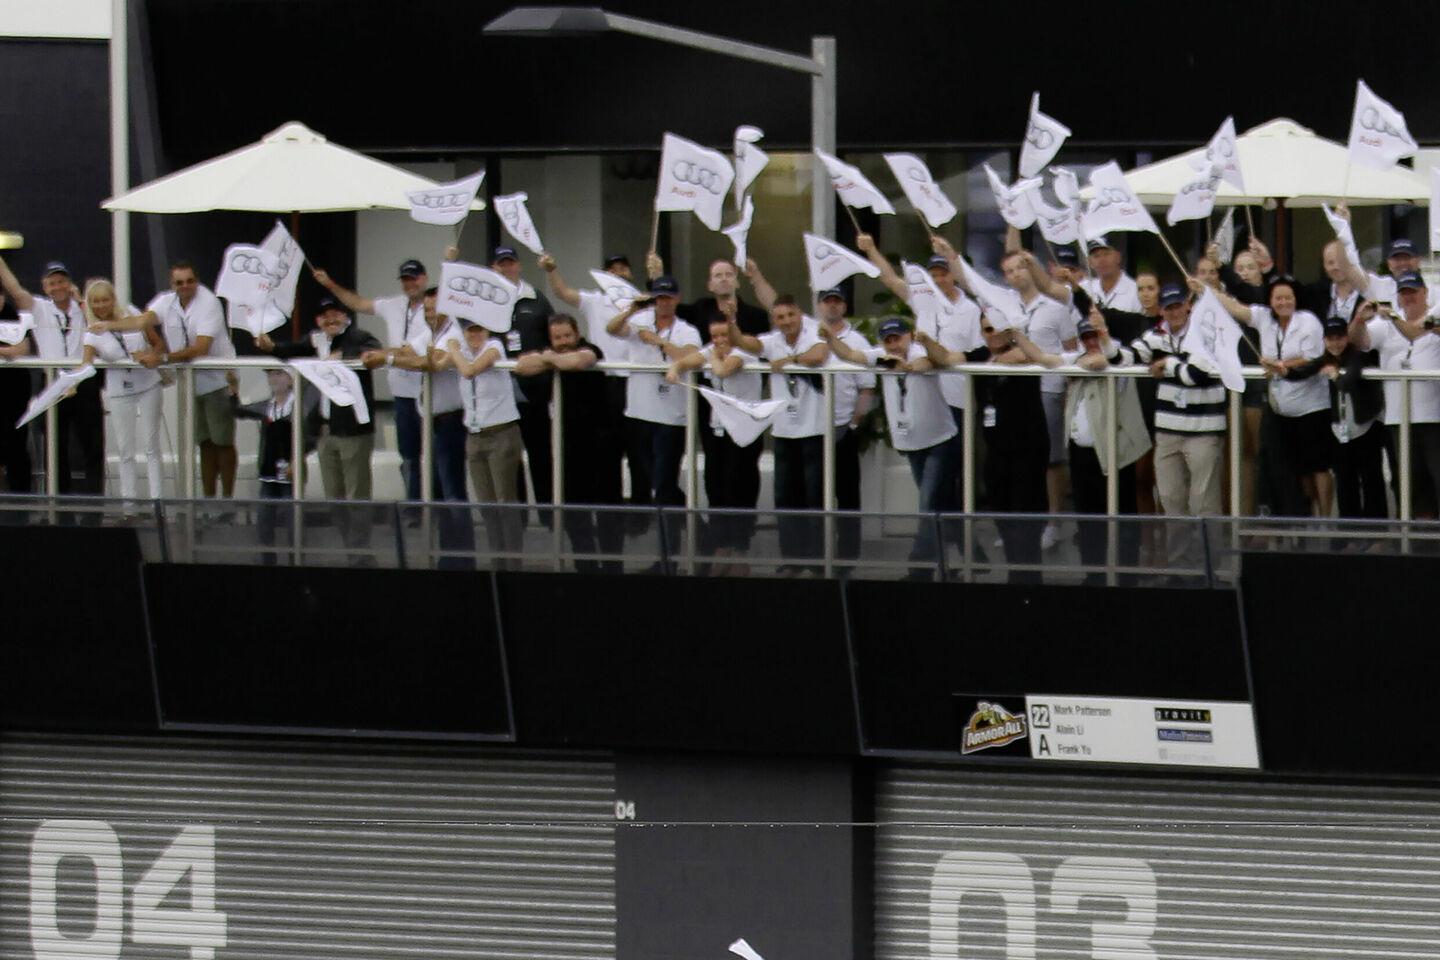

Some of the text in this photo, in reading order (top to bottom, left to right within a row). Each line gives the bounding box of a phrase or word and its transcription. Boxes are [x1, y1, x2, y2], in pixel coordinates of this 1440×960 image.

[1032, 706, 1050, 727] 22
[1054, 704, 1112, 717] Mark Patterson
[967, 722, 1022, 747] ARMORALL
[1039, 734, 1051, 756] A
[1058, 744, 1078, 755] Frank
[615, 800, 636, 820] 04
